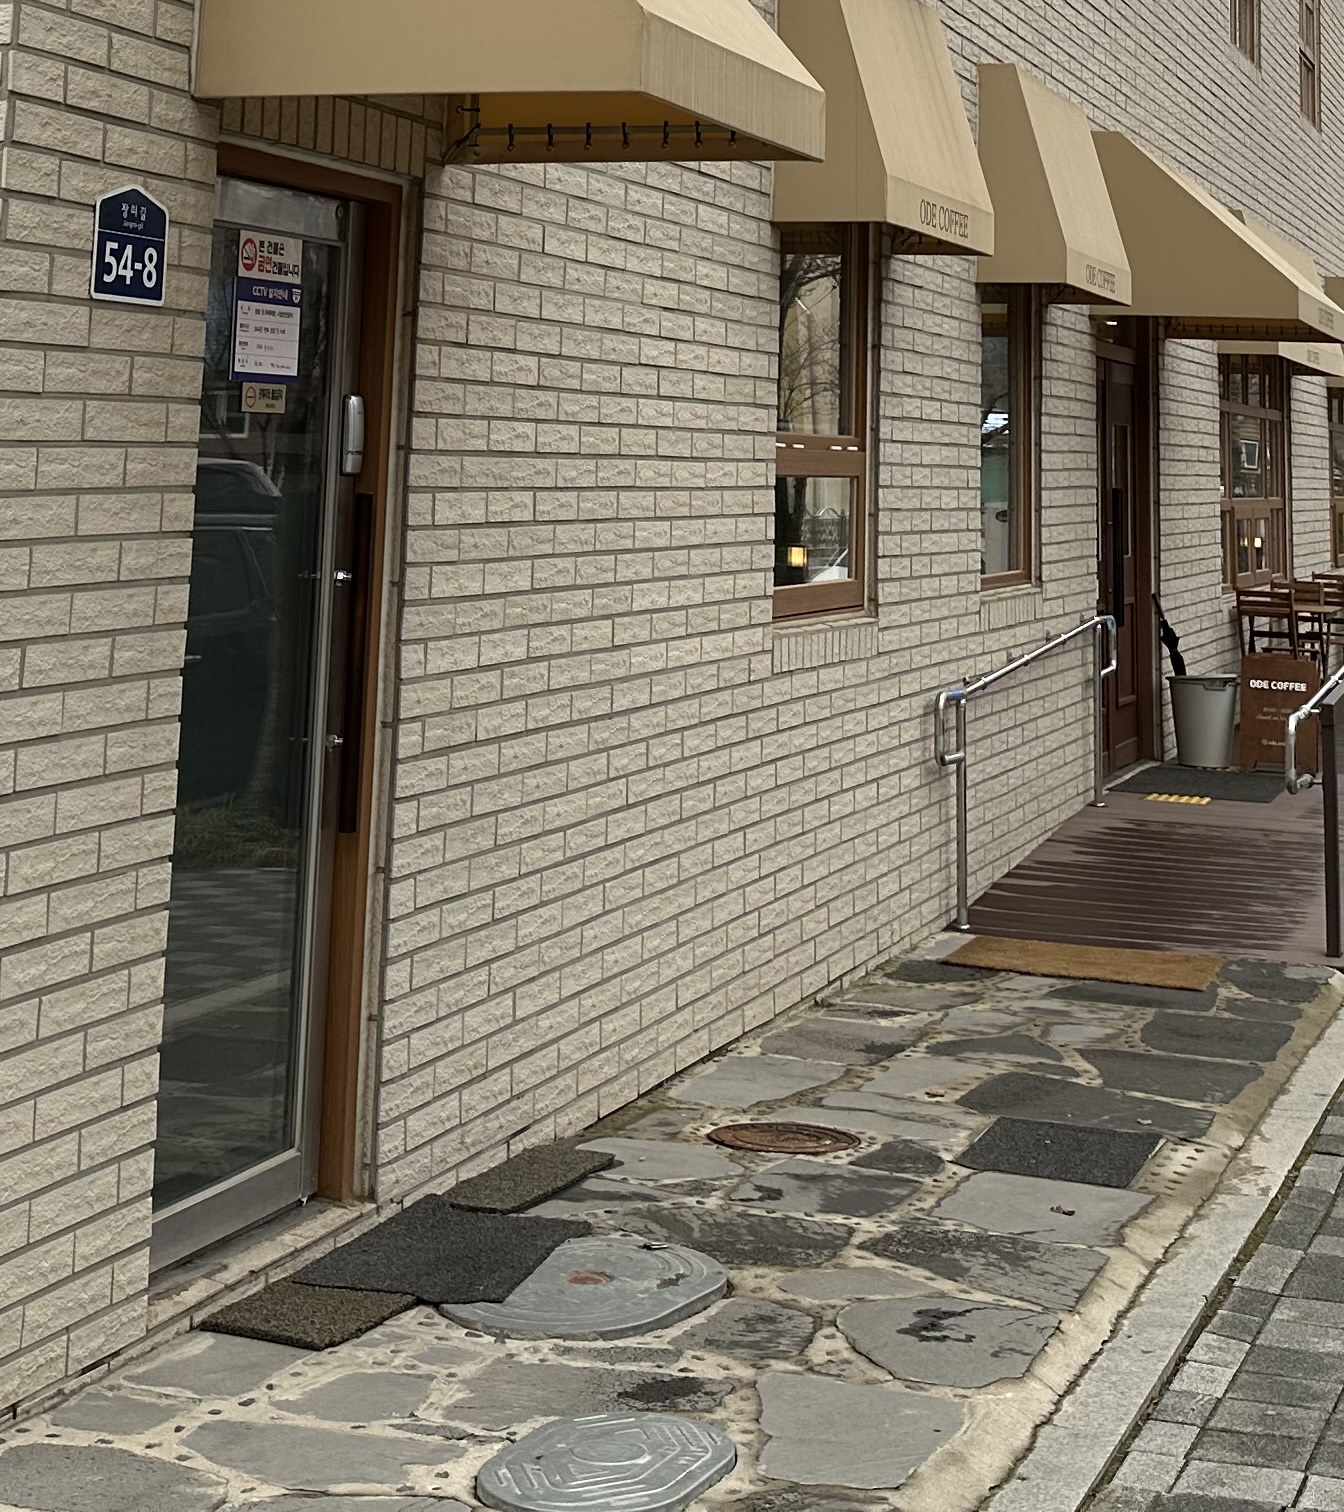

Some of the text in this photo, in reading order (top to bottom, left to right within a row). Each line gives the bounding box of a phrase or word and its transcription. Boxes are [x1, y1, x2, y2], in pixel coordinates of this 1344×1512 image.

[919, 198, 969, 239] ODE COFFEE
[103, 241, 158, 288] 54-8
[252, 285, 268, 297] CCTV
[1249, 679, 1307, 692] ODE COFFEE
